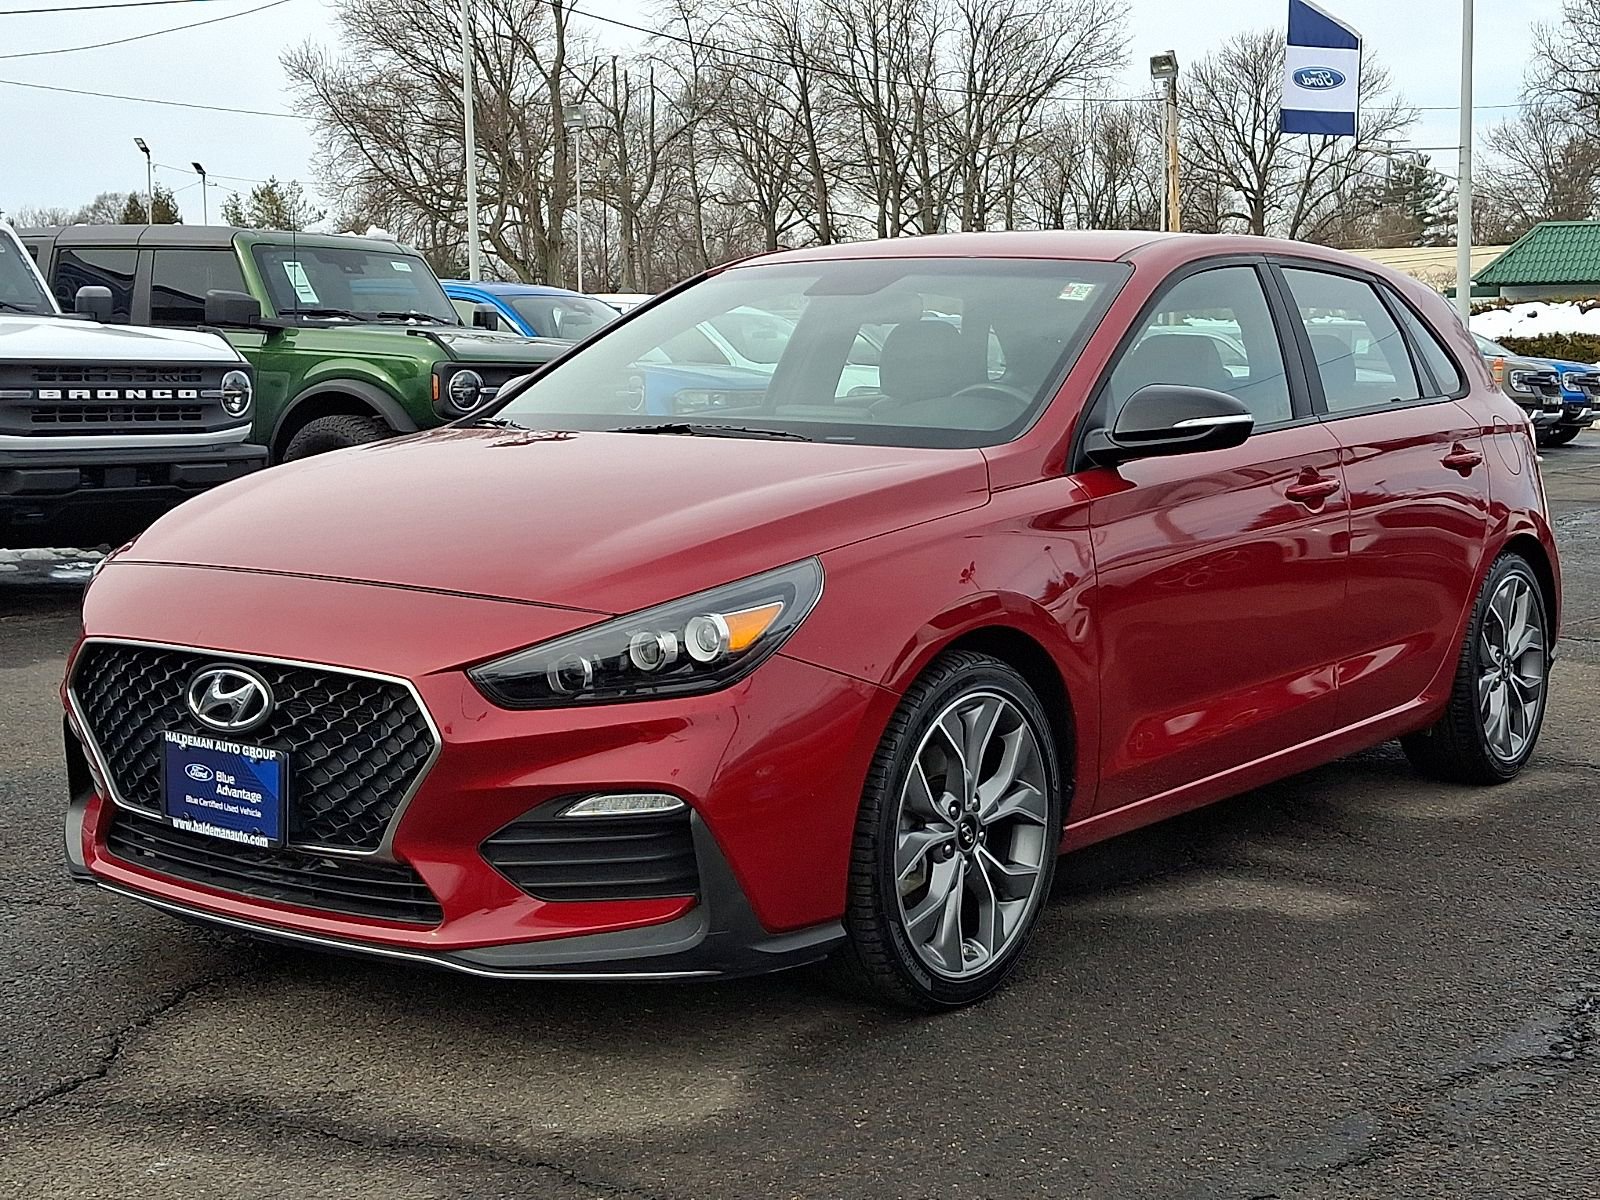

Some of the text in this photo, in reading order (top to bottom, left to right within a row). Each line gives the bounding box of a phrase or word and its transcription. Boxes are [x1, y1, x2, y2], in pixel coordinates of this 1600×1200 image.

[38, 389, 198, 400] BRONCO
[164, 730, 277, 760] HALDEMAN AUTO GROUP
[190, 765, 208, 779] Ford
[215, 770, 236, 785] Blue
[216, 783, 262, 804] Advantage
[185, 794, 262, 818] Blue Certified Used Vehicle
[172, 817, 269, 848] www.haldemanauto.com
